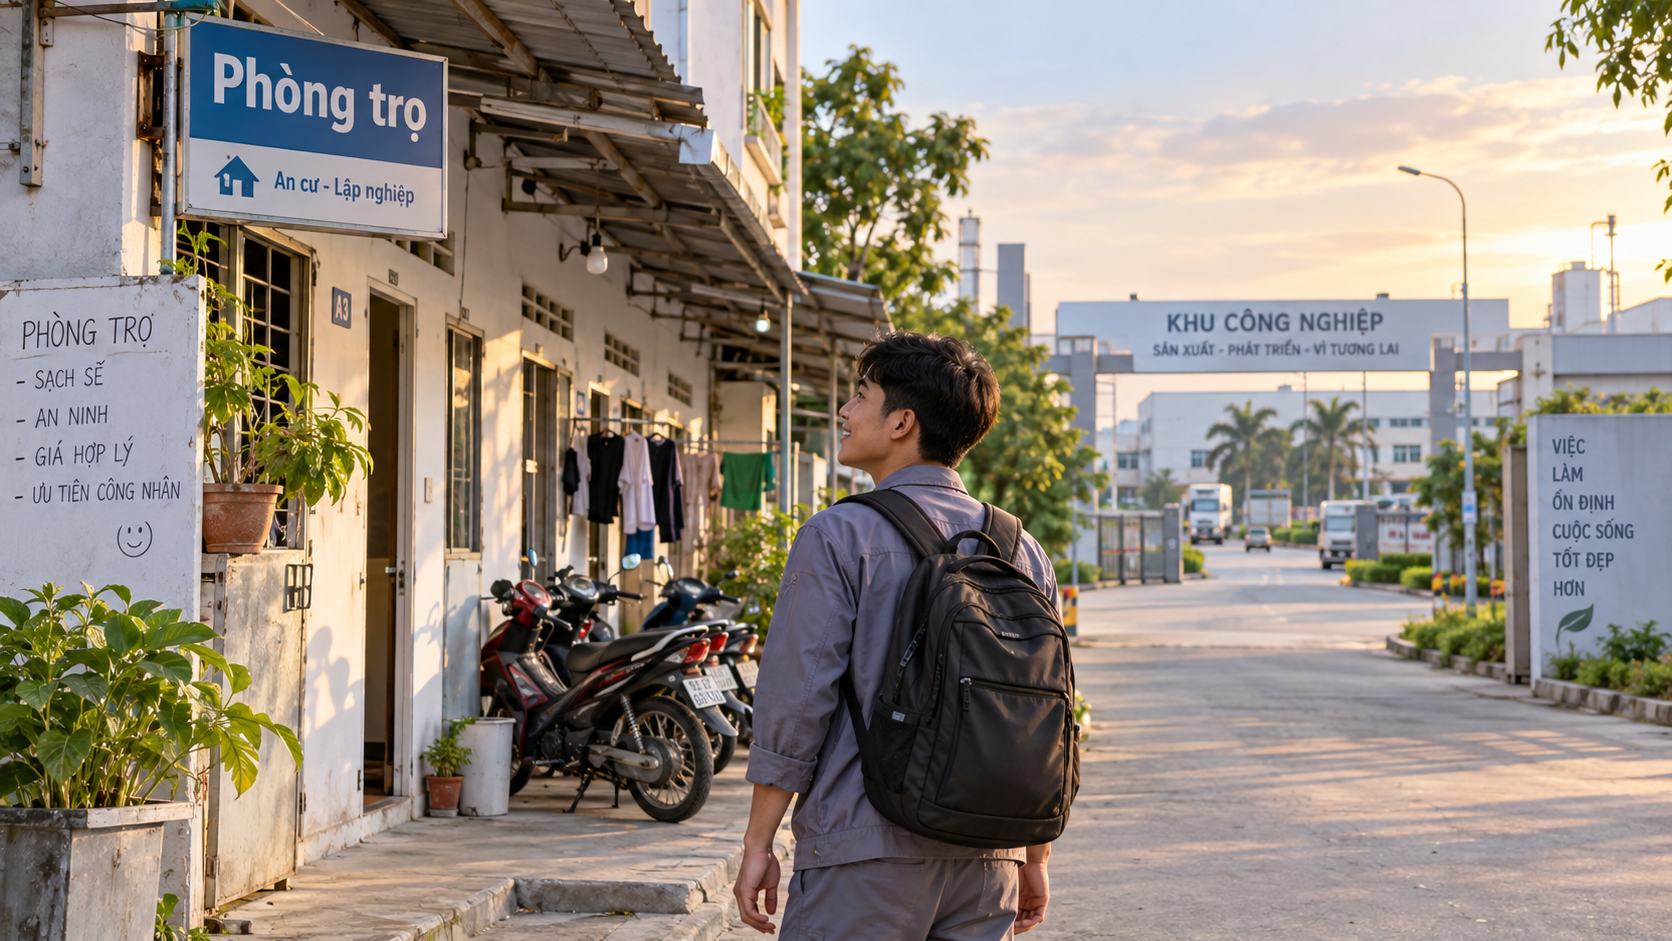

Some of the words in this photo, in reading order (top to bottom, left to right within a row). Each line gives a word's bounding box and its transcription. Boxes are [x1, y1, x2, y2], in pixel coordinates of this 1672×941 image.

[213, 52, 356, 134] Phòng
[369, 82, 428, 143] trọ
[274, 171, 296, 190] An
[300, 177, 320, 194] cư
[335, 177, 361, 202] Lập
[366, 183, 415, 207] nghiệp
[335, 294, 349, 321] A3
[22, 311, 97, 350] PHÒNG
[1167, 313, 1215, 332] KHU
[1224, 308, 1290, 332] CÔNG
[1300, 308, 1384, 336] NGHIỆP
[1183, 340, 1215, 356] XUẤT
[1313, 340, 1326, 355] VÌ
[1330, 342, 1375, 356] TƯƠNG
[1379, 343, 1399, 355] LAI
[34, 369, 75, 393] SẠCH
[35, 408, 59, 428] AN
[69, 405, 108, 426] NINH
[35, 440, 64, 467] GIÁ
[73, 442, 106, 468] HỢP
[114, 435, 134, 467] LÝ
[1552, 435, 1586, 458] VIỆC
[1552, 463, 1584, 482] LÀM
[32, 482, 52, 504] ƯU
[58, 479, 90, 503] TIÊN
[96, 477, 135, 501] CÔNG
[142, 475, 181, 500] NHÂN
[1578, 494, 1615, 514] ĐỊNH
[1552, 520, 1591, 543] CUỘC
[1595, 518, 1635, 540] SỐNG
[1552, 546, 1581, 568] TỐT
[1585, 552, 1615, 572] ĐẸP
[1553, 579, 1585, 597] HƠN
